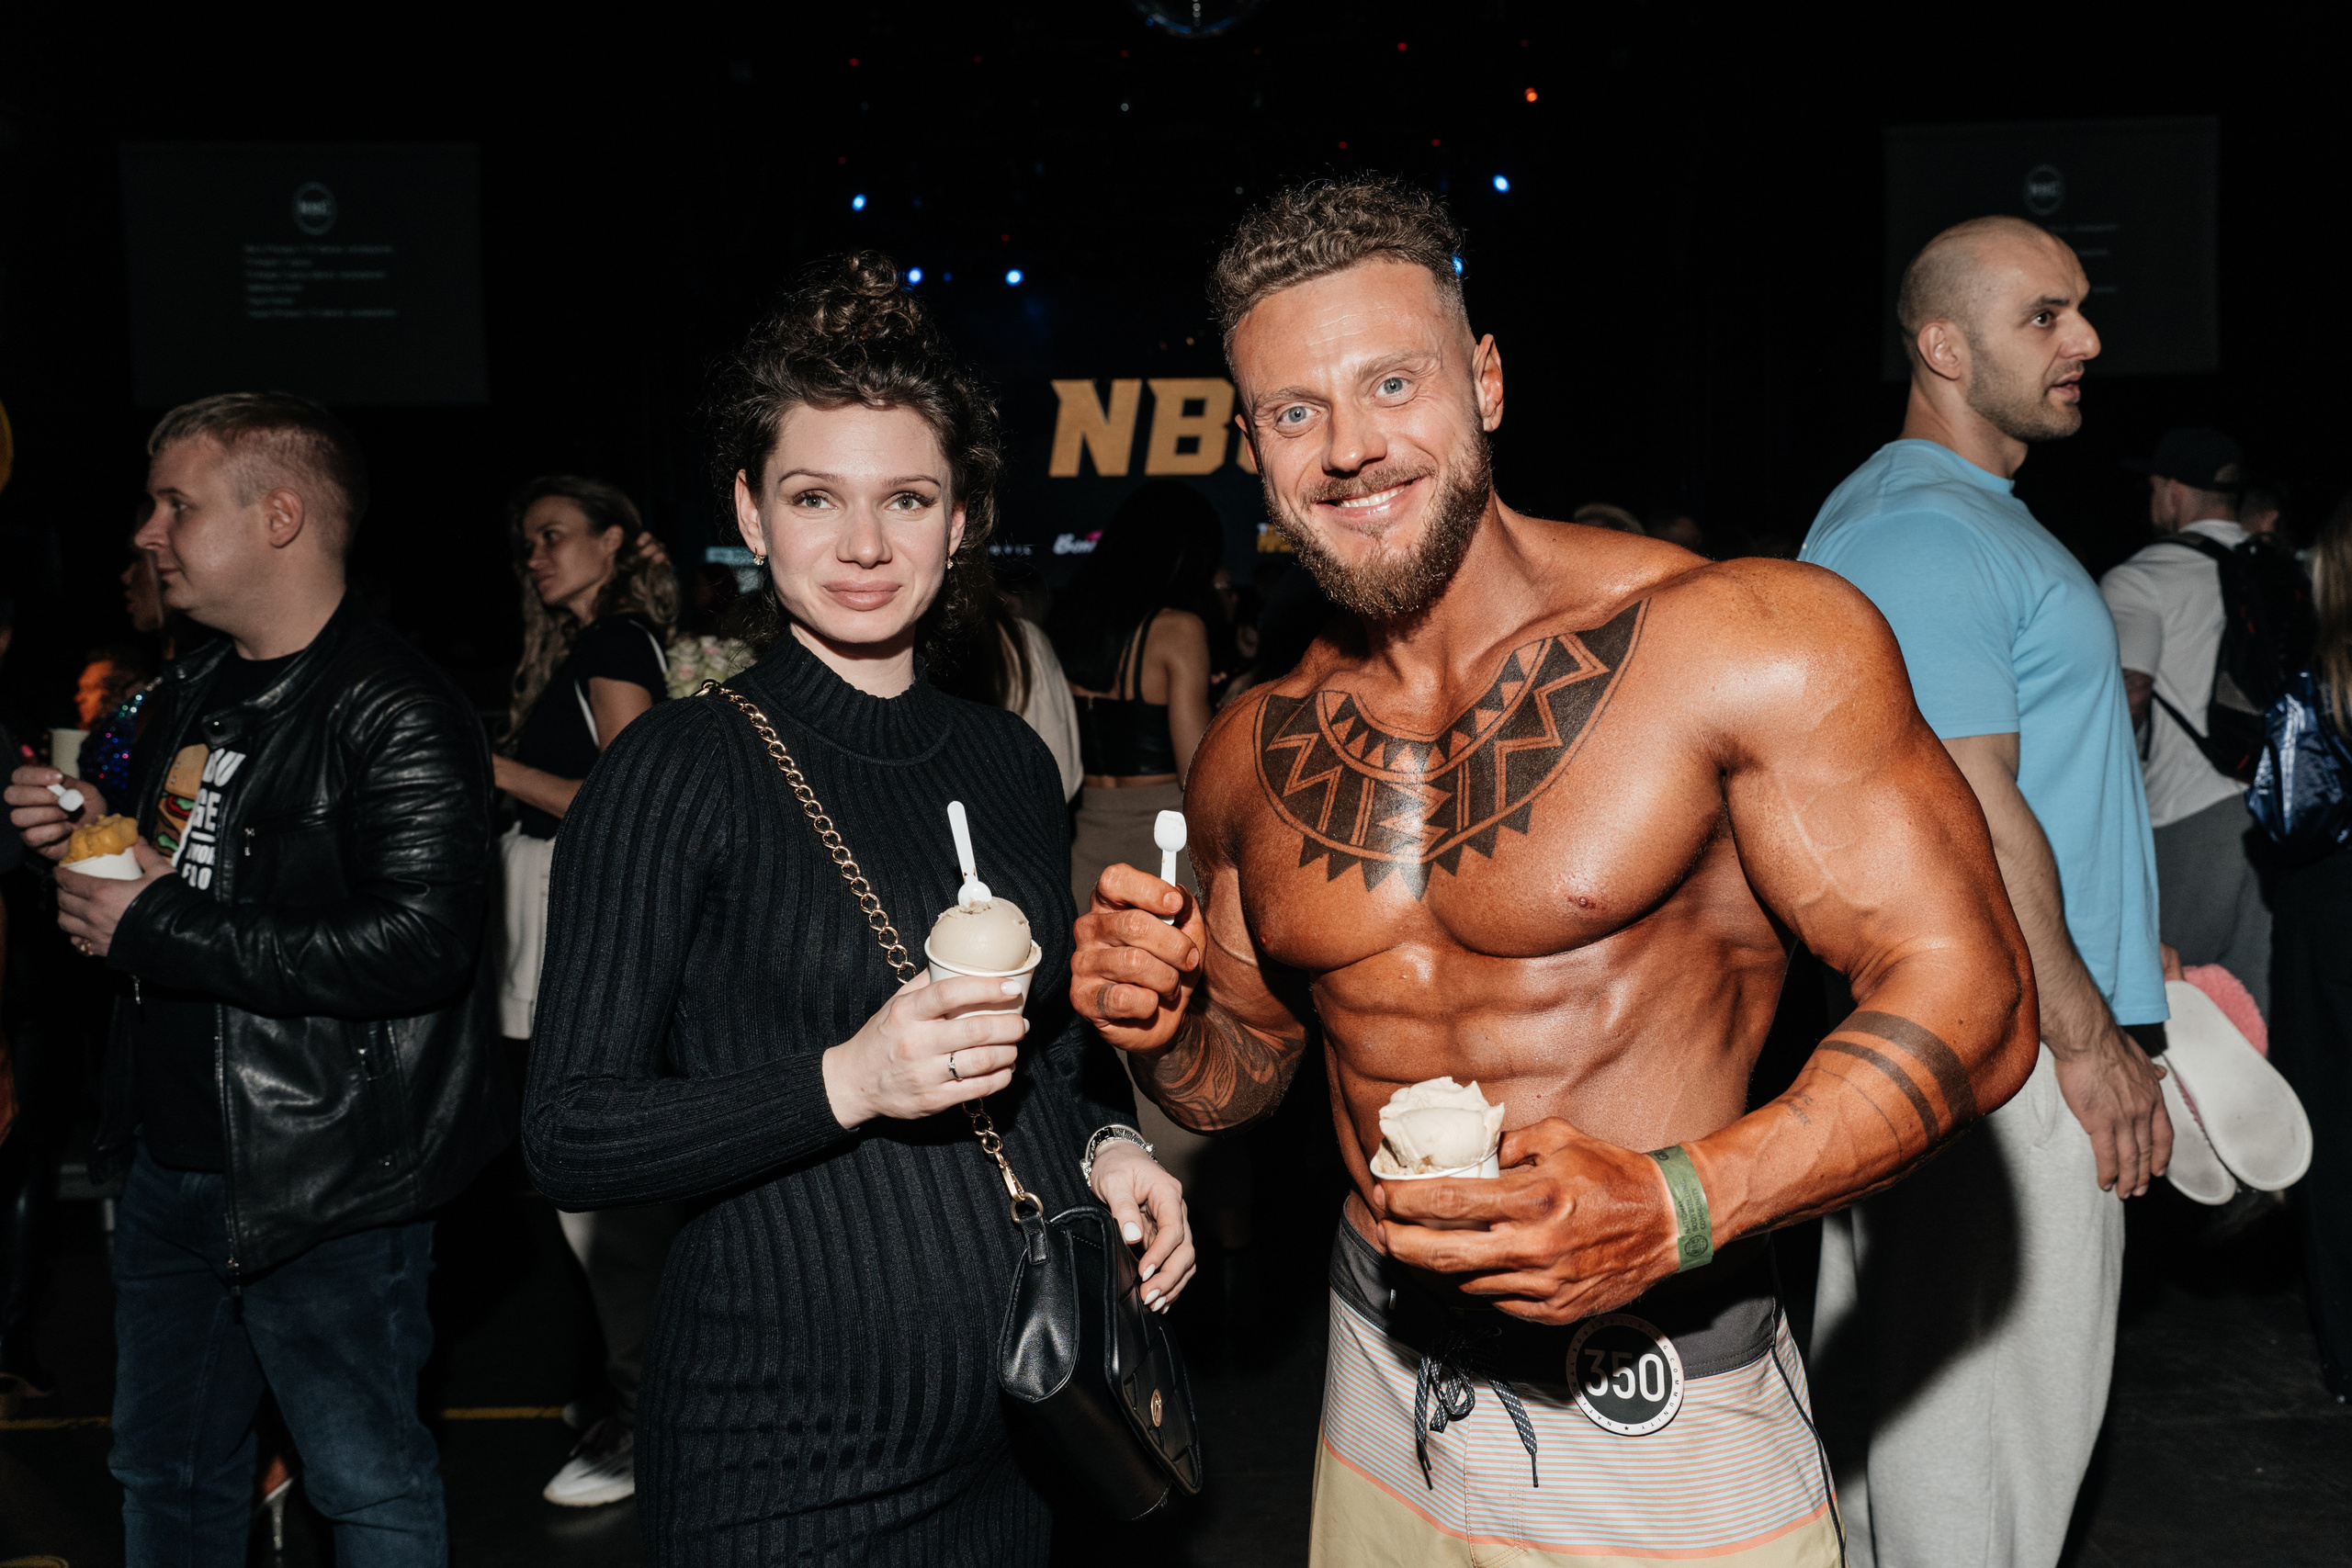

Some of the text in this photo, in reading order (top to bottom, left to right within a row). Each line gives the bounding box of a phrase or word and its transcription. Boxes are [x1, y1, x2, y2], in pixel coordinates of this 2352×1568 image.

[1048, 378, 1260, 478] NB
[1679, 1179, 1699, 1232] BODYBUILDING
[1691, 1188, 1706, 1230] COMMUNITY
[1570, 1319, 1679, 1430] NATIONAL BODYBUILDING COMMUNITY
[1584, 1348, 1666, 1403] 350
